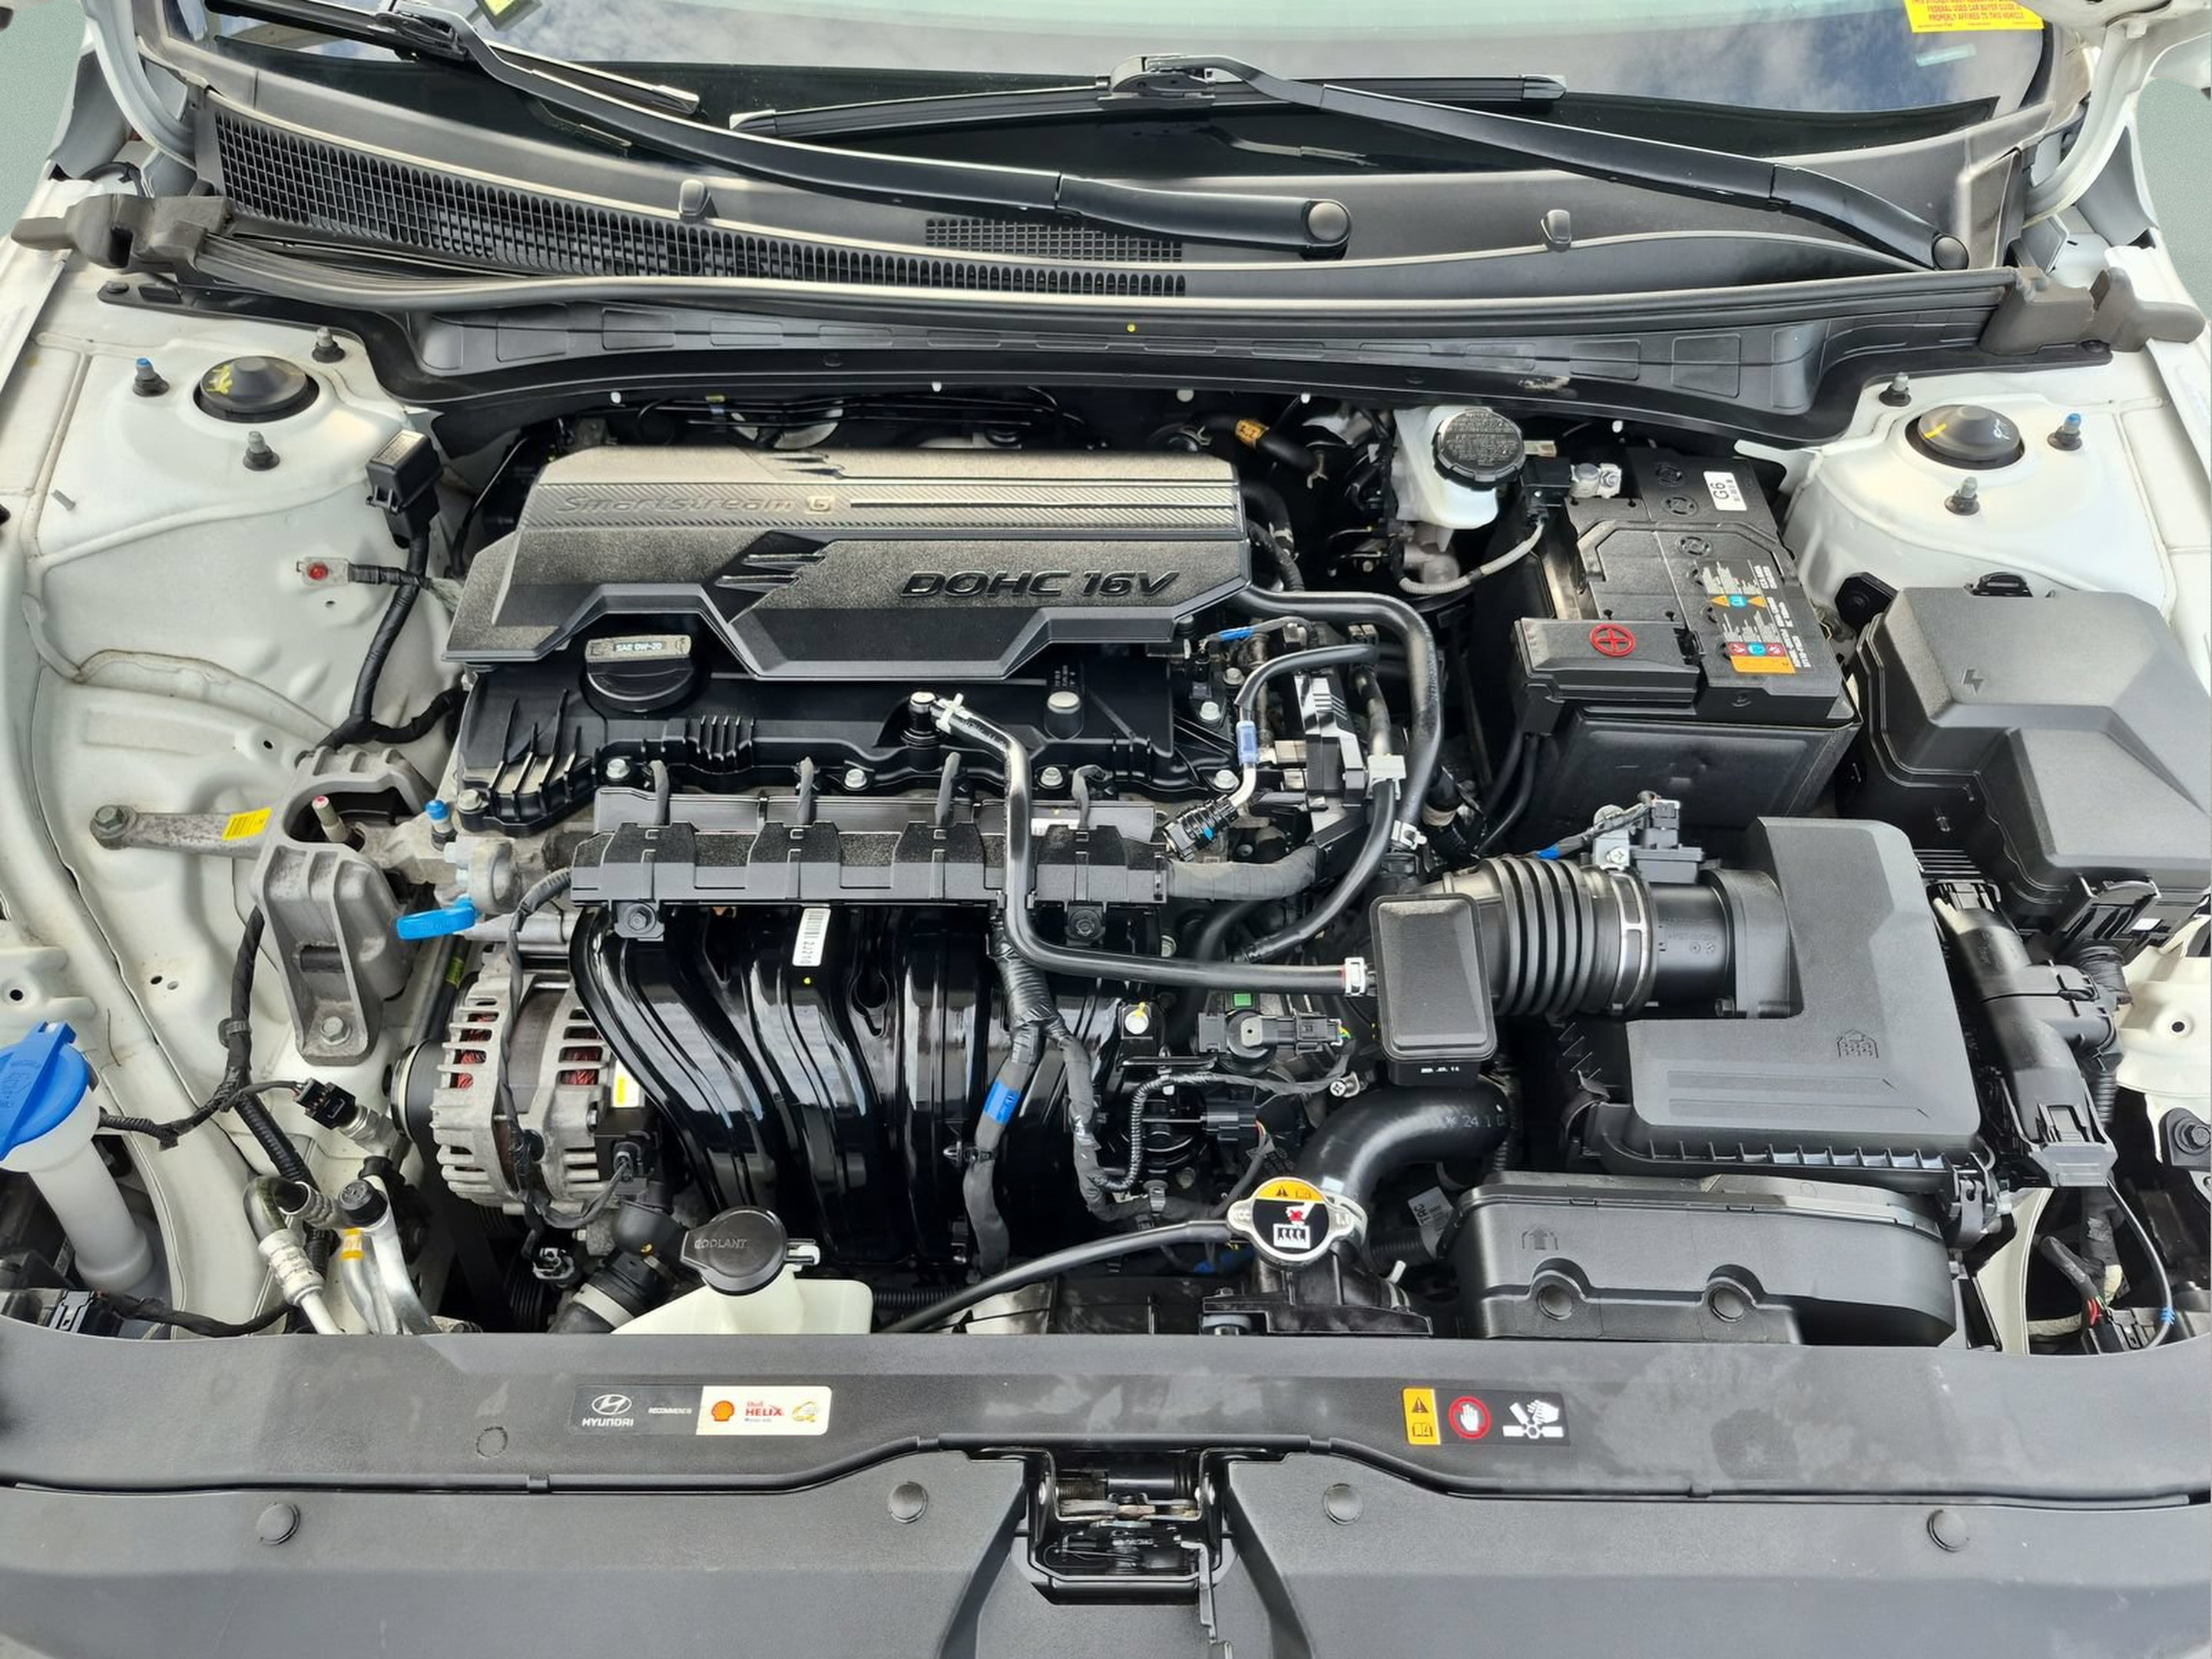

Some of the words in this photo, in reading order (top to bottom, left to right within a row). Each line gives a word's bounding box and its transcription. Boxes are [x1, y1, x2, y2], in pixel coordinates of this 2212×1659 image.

[1710, 482, 1730, 499] G6
[557, 495, 796, 513] Smartstream
[900, 571, 1071, 597] DOHC
[1081, 571, 1180, 597] 16V
[615, 644, 633, 652] SAE
[634, 642, 663, 652] 0W-20
[694, 1238, 747, 1250] COOLANT
[745, 1408, 783, 1416] HELIX
[581, 1417, 634, 1427] HYUNDAI
